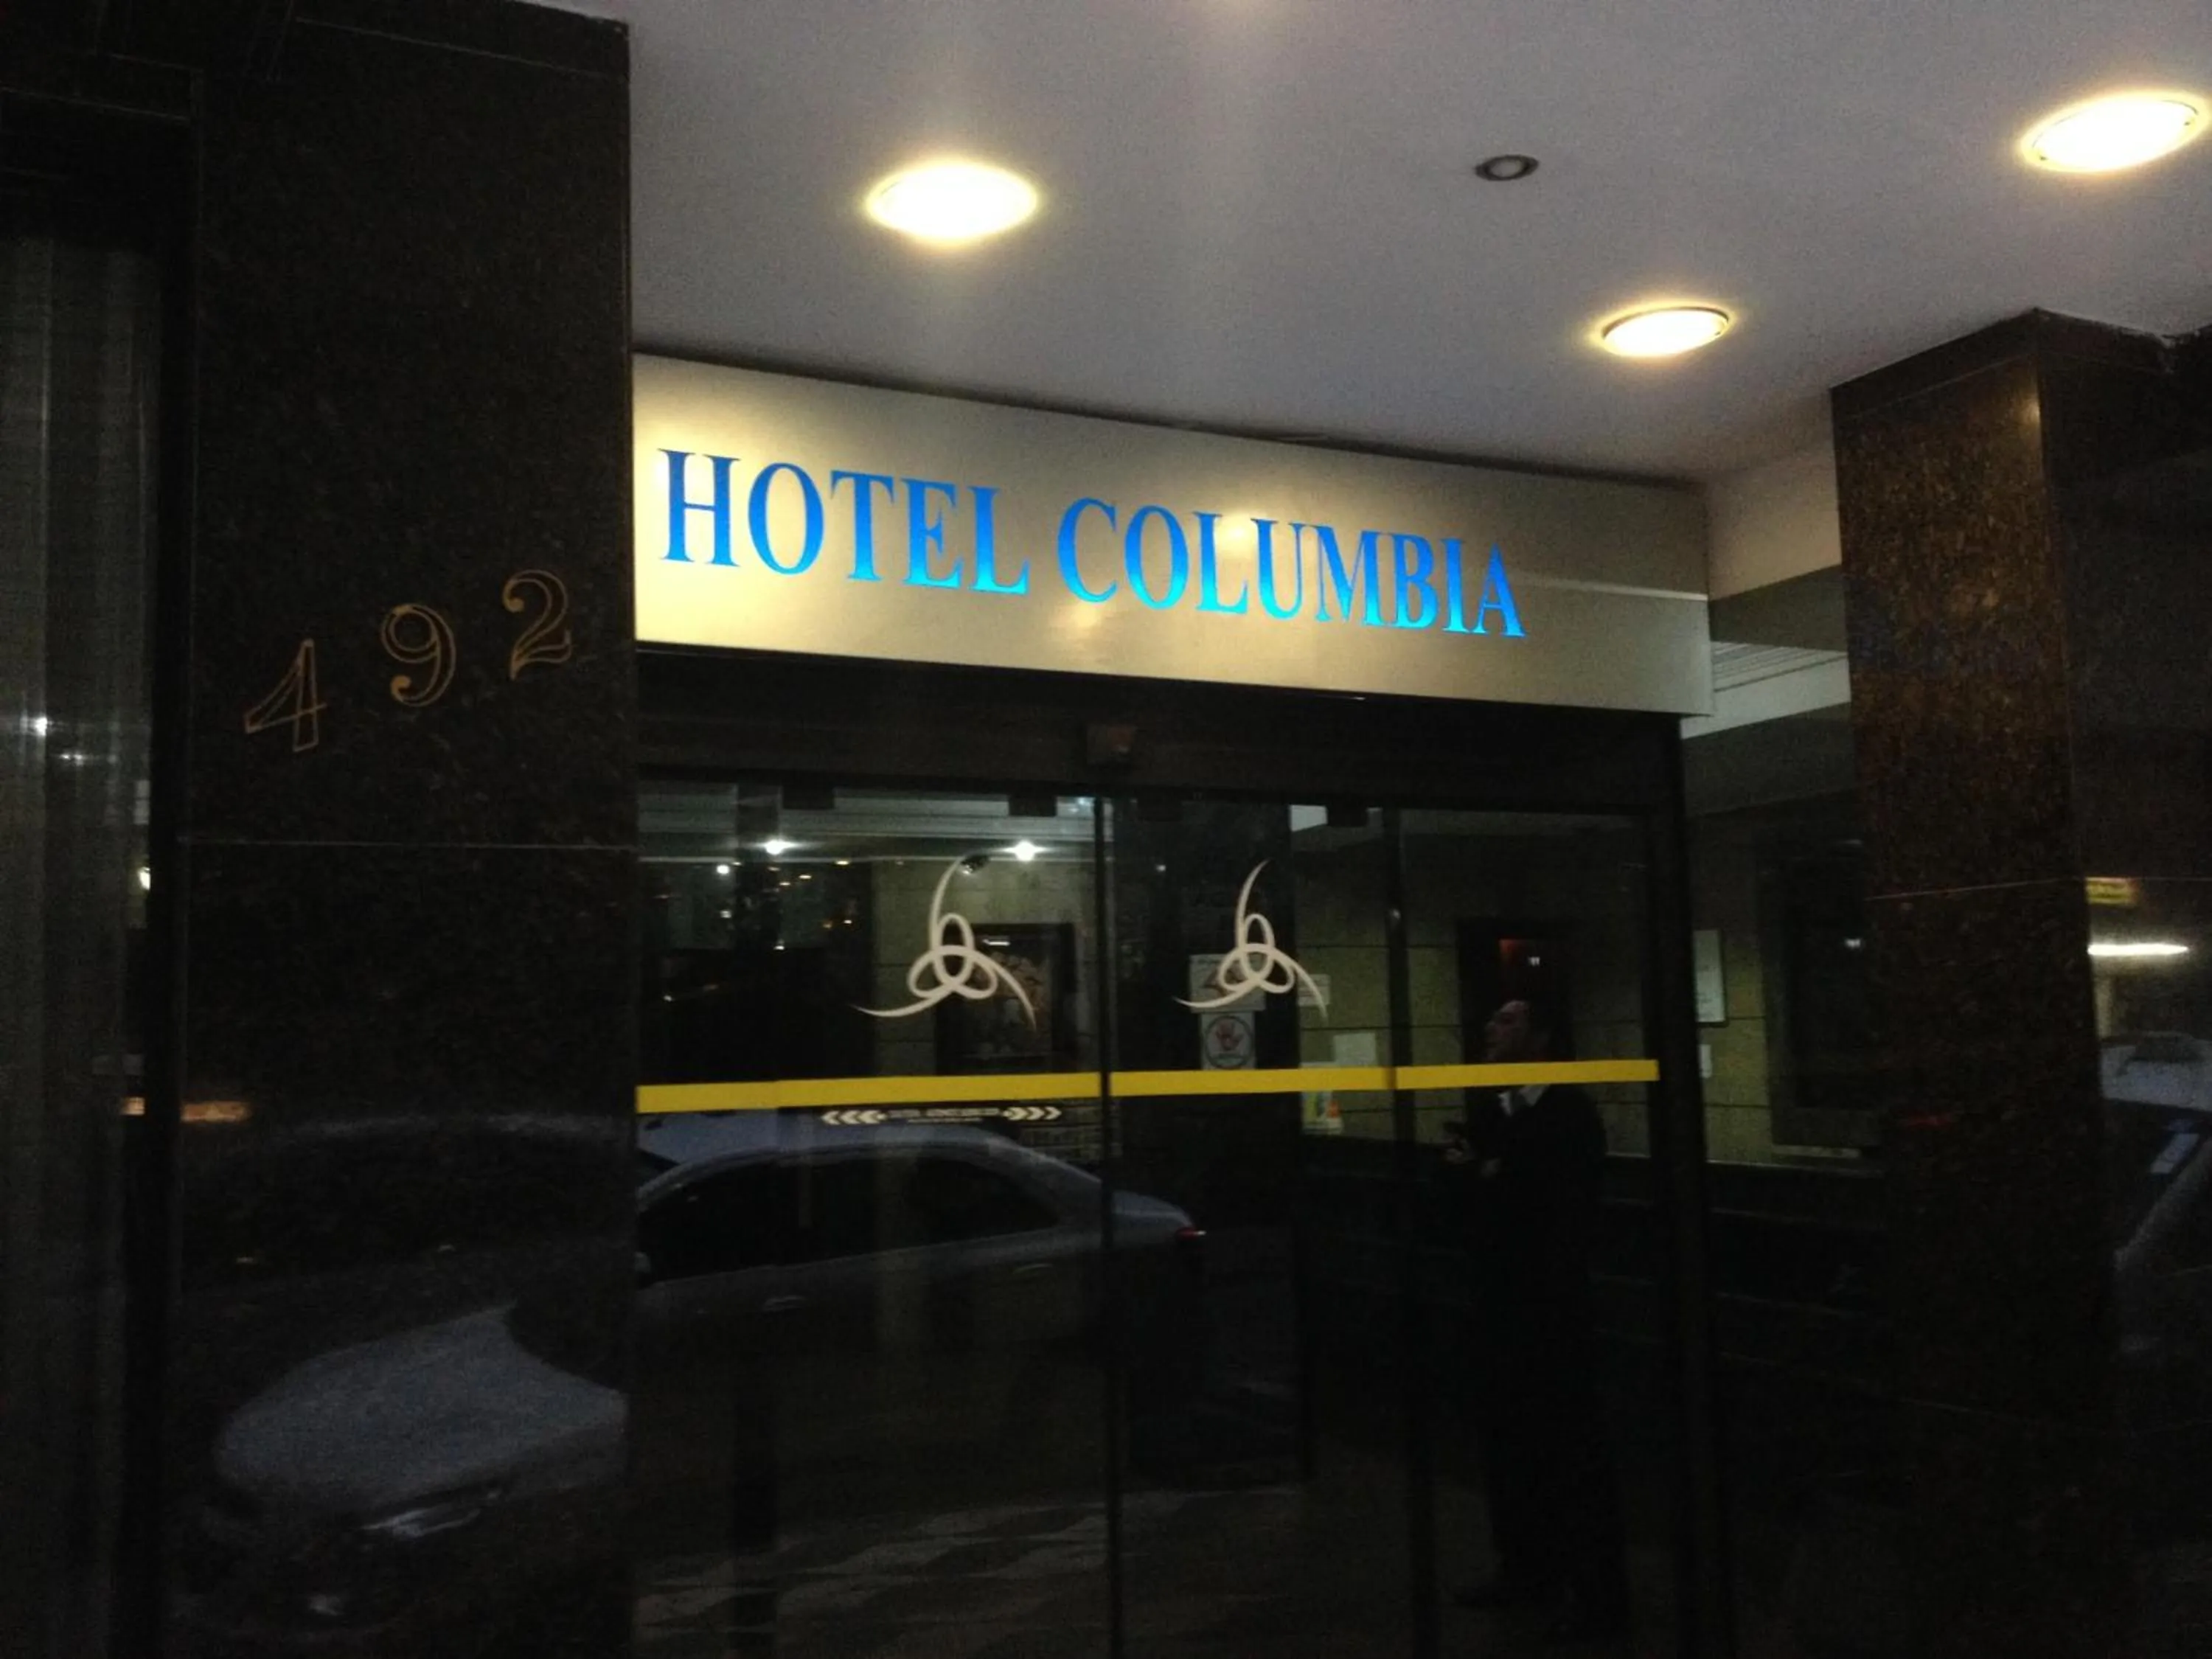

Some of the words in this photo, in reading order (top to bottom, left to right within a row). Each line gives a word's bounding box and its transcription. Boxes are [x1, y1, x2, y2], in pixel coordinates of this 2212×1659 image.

[658, 448, 1029, 595] HOTEL
[1057, 497, 1526, 637] COLUMBIA
[244, 569, 572, 753] 492
